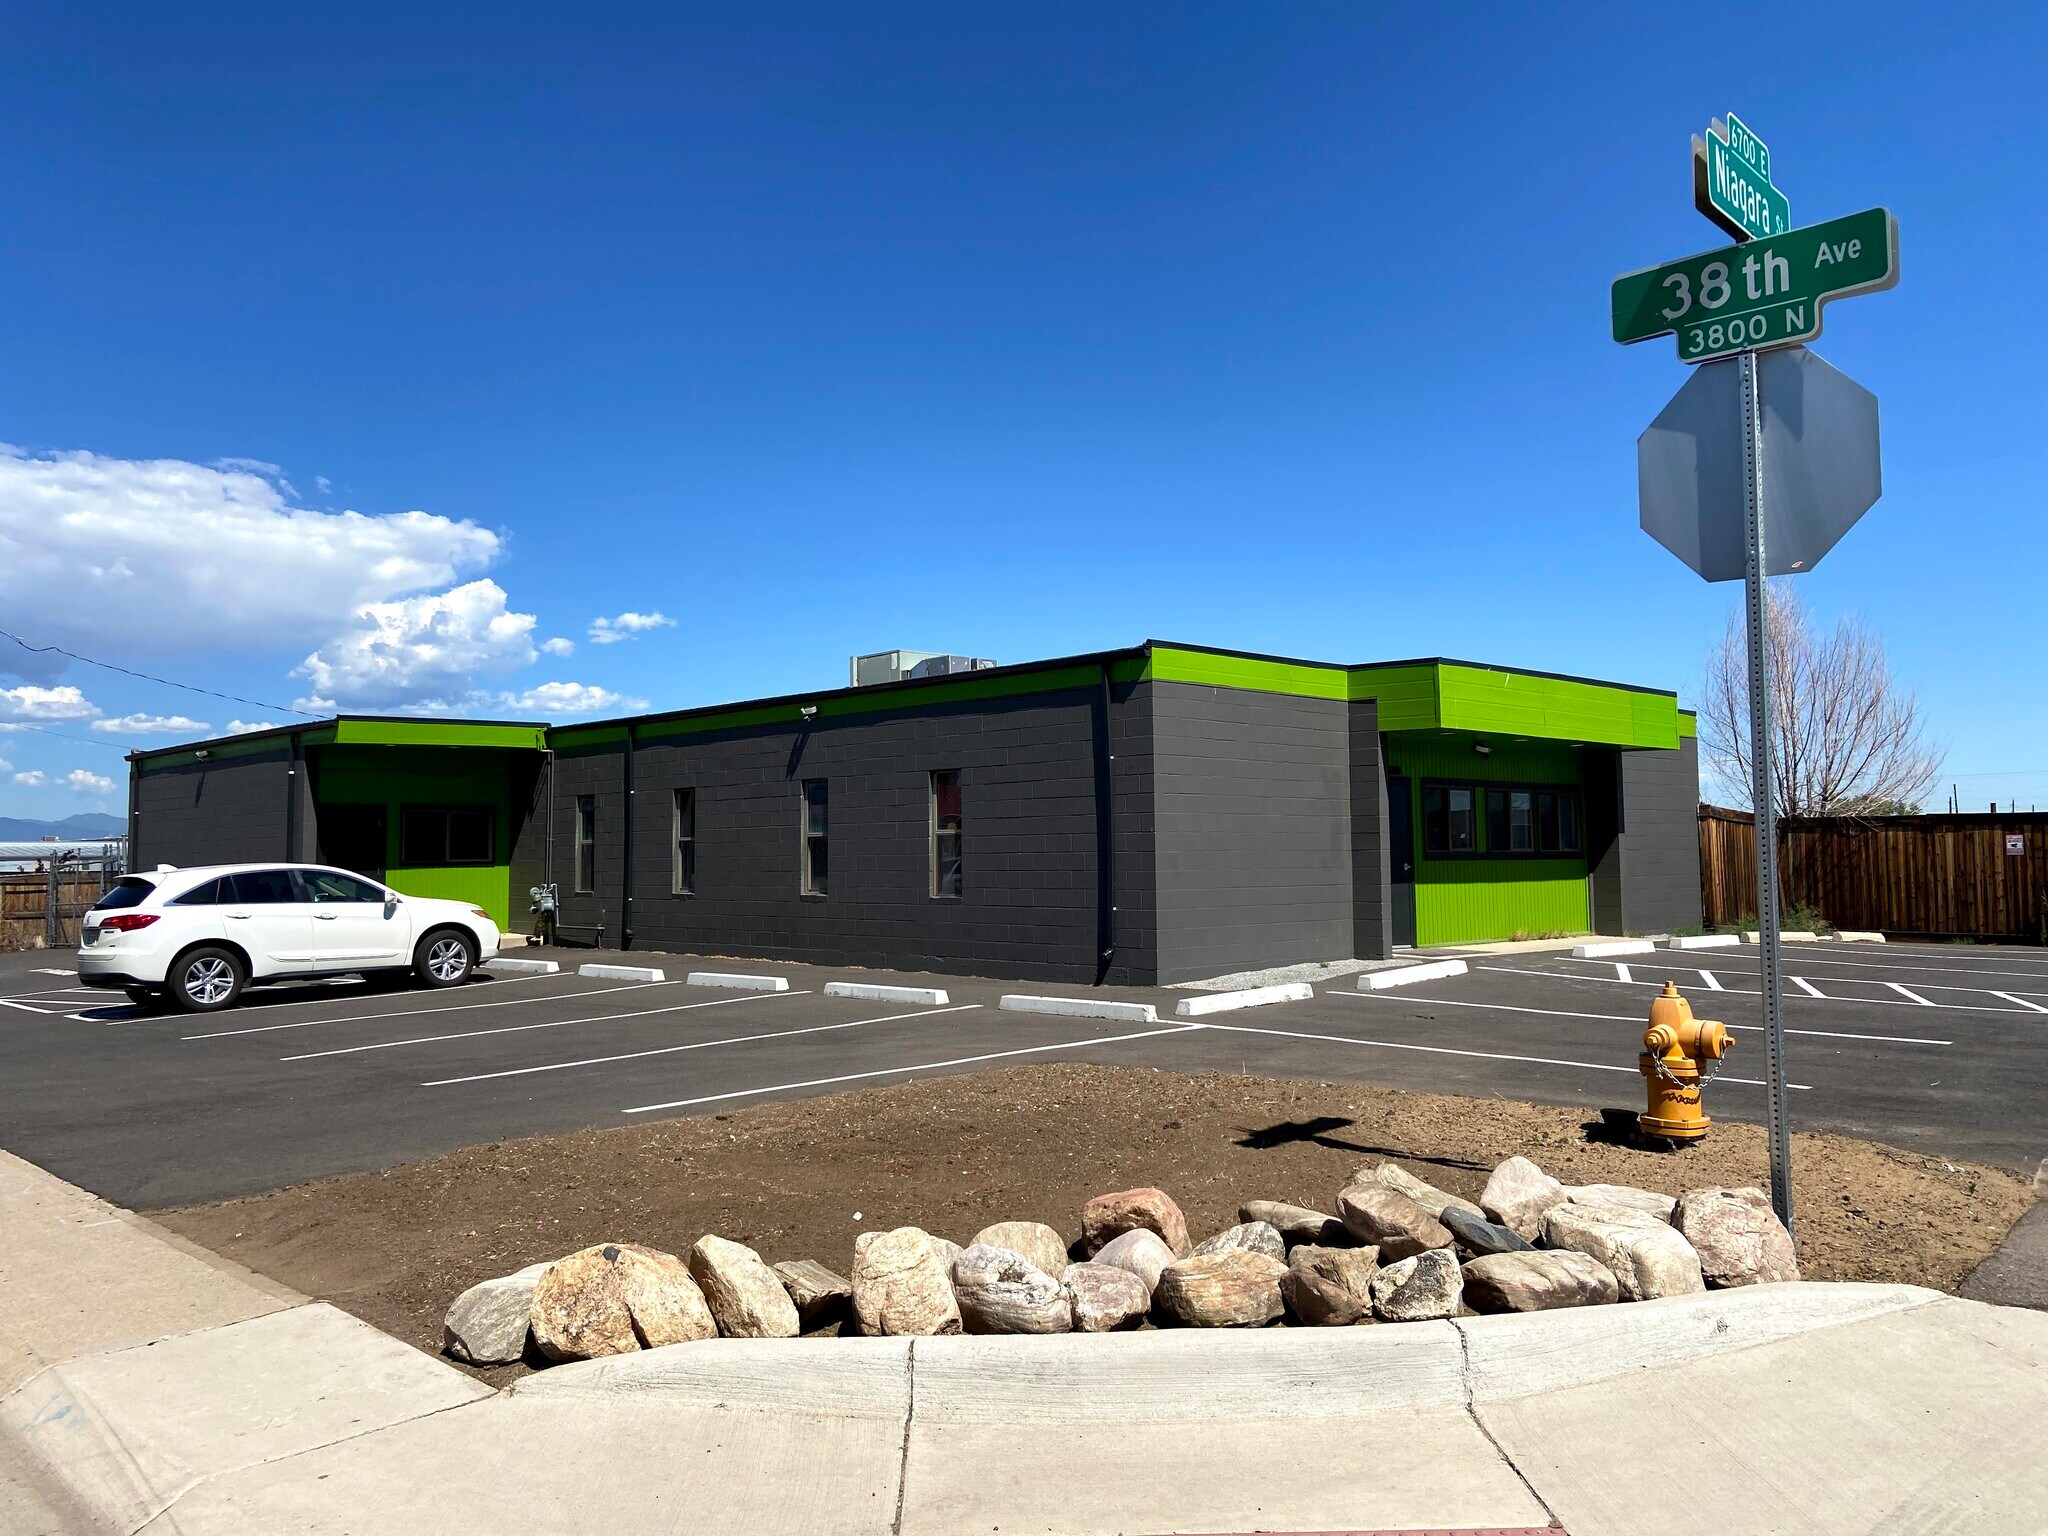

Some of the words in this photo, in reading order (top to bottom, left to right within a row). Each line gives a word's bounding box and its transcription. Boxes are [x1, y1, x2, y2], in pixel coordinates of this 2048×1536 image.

[1731, 124, 1755, 165] 6700
[1760, 150, 1767, 175] E
[1715, 144, 1770, 234] Niagara
[1775, 214, 1784, 234] St
[1814, 238, 1861, 268] Ave
[1689, 315, 1767, 353] 3800
[1786, 305, 1804, 332] N
